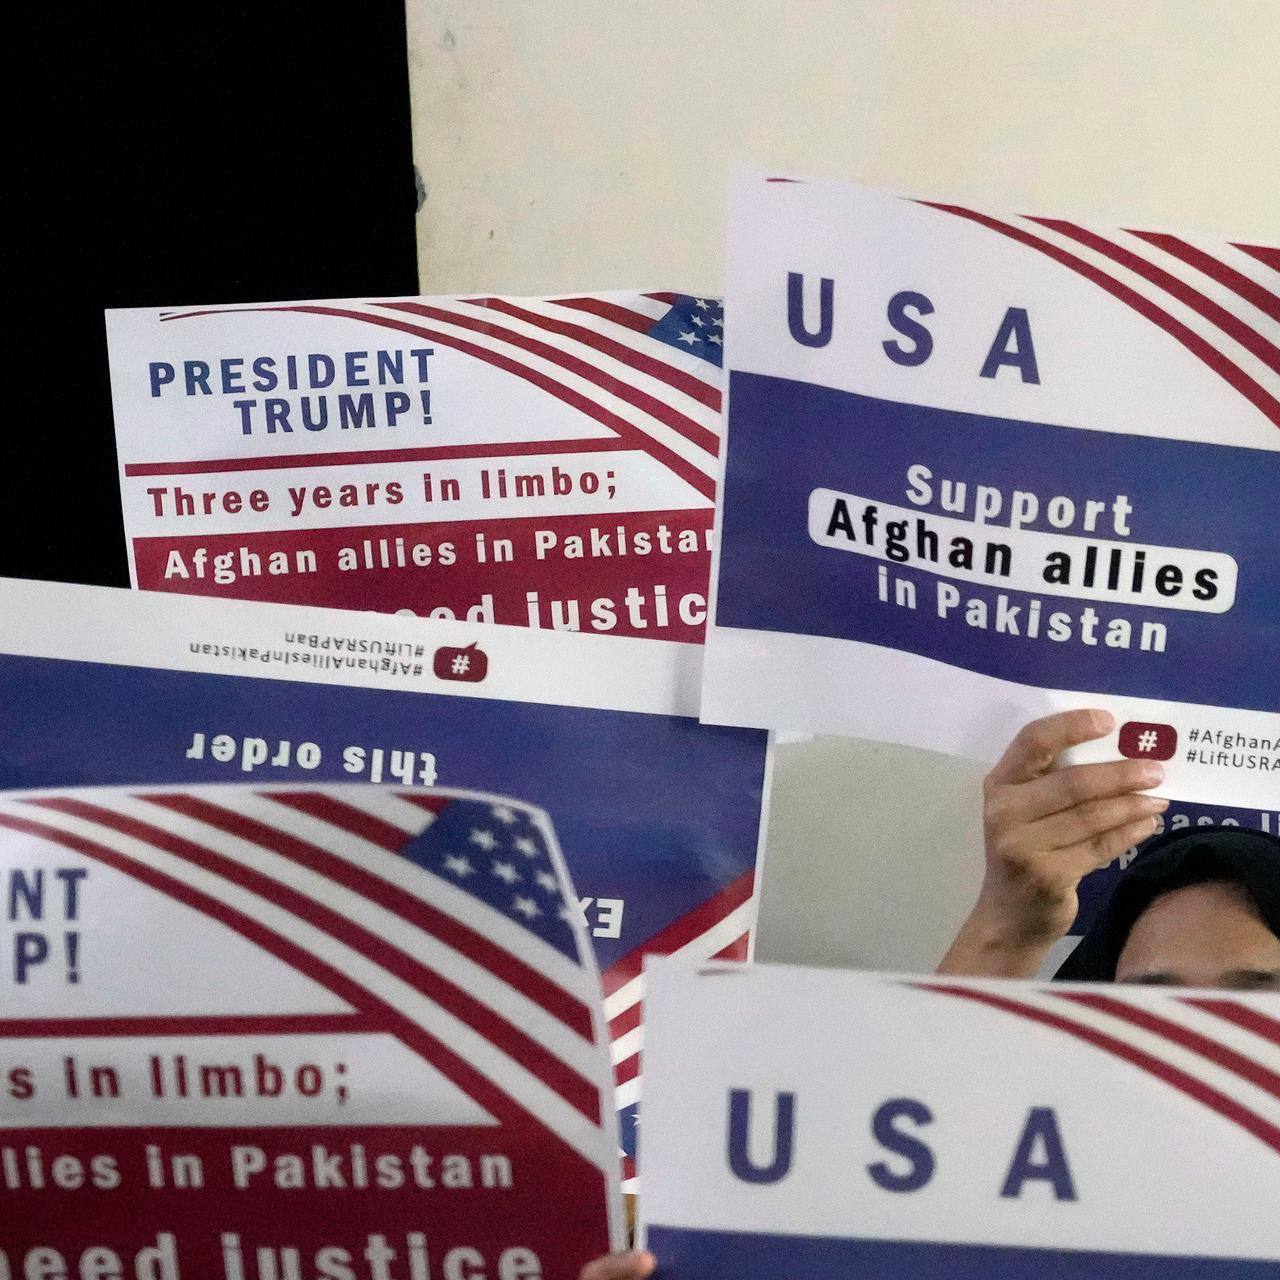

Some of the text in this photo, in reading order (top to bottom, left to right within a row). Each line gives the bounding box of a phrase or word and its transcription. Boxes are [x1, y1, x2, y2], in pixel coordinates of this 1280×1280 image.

[785, 271, 1042, 386] USA
[149, 347, 436, 398] PRESIDENT
[232, 390, 436, 437] TRUMP!
[147, 465, 618, 521] Three years in limbo;
[904, 463, 1133, 538] Support
[163, 542, 319, 585] Afghan
[337, 536, 458, 573] allies
[475, 531, 515, 565] in
[825, 499, 1220, 603] Afghan allies
[876, 567, 1169, 654] in Pakistan
[189, 641, 425, 678] #AfghanAlliesInPakistan
[186, 733, 439, 787] this order
[7, 868, 88, 921] NT
[13, 929, 84, 984] P!
[64, 1056, 121, 1099] in
[149, 1053, 350, 1105] limbo;
[145, 1144, 206, 1189] in
[230, 1143, 515, 1190] Pakistan
[726, 1087, 1079, 1204] USA
